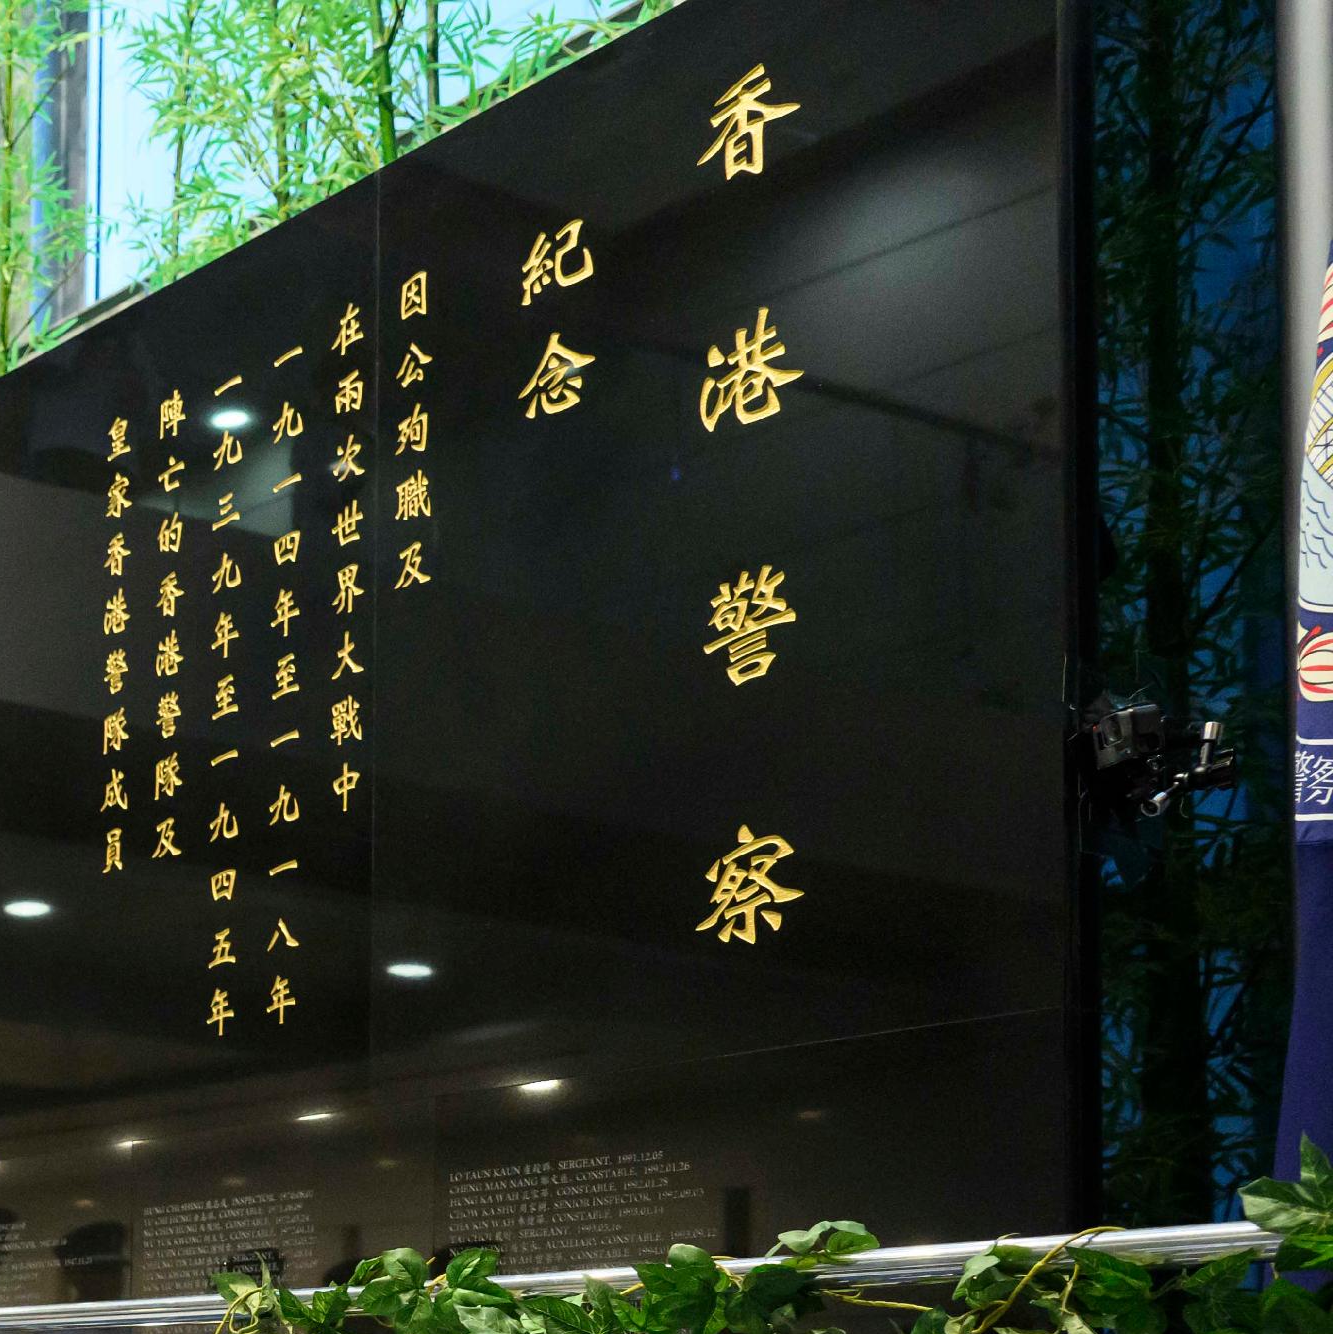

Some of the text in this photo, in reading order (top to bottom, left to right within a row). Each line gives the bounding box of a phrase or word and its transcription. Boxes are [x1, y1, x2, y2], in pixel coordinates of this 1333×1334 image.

[330, 303, 365, 812] 在兩次世界大戰中
[394, 271, 433, 590] 因公殉職及
[518, 218, 596, 420] 紀念
[695, 63, 805, 945] 香港警察
[100, 416, 133, 874] 皇家香港警隊成員
[152, 389, 187, 858] 陣亡的香港警隊及
[206, 374, 243, 1037] 一九三九年至一九四五年
[266, 346, 304, 1025] 一九一四年至一九一八年
